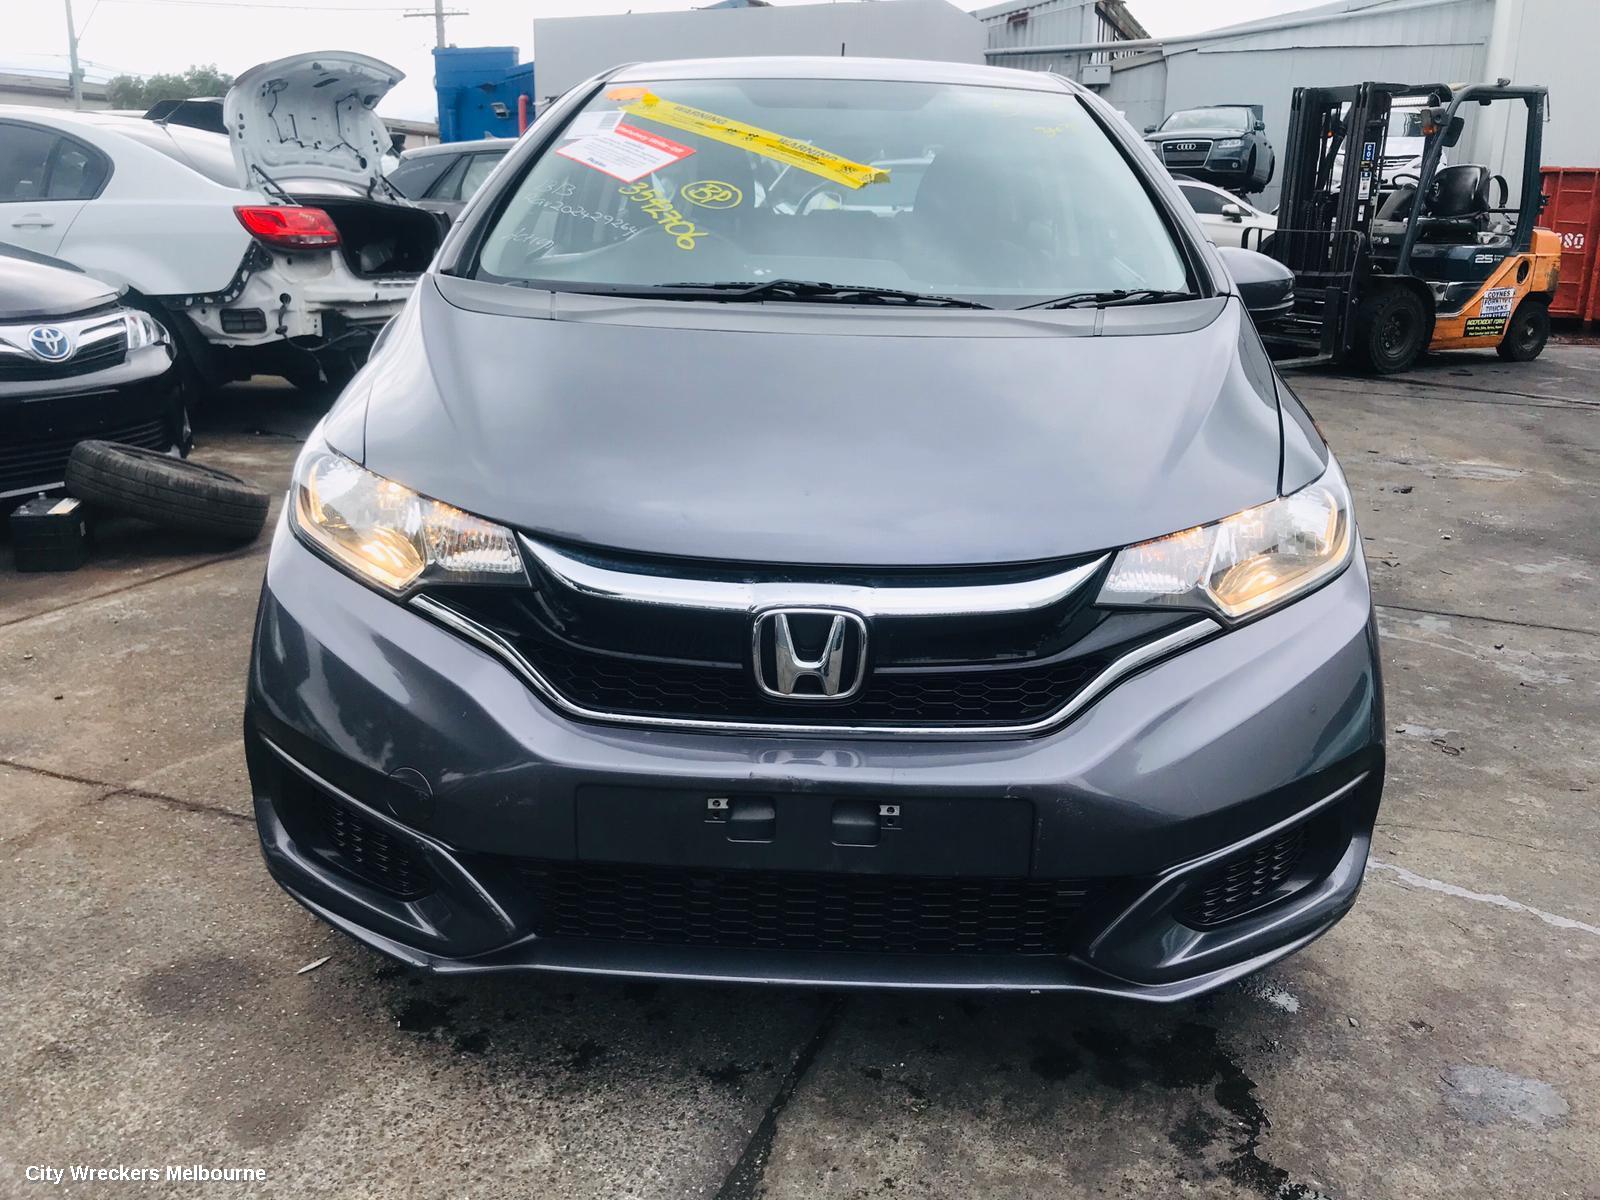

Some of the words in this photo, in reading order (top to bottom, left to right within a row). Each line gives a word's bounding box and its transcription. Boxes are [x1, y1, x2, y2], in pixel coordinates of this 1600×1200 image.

[673, 105, 728, 126] WARNING
[779, 136, 839, 162] WARNING
[1487, 290, 1511, 298] COYNES
[1485, 304, 1509, 312] TRUCKS
